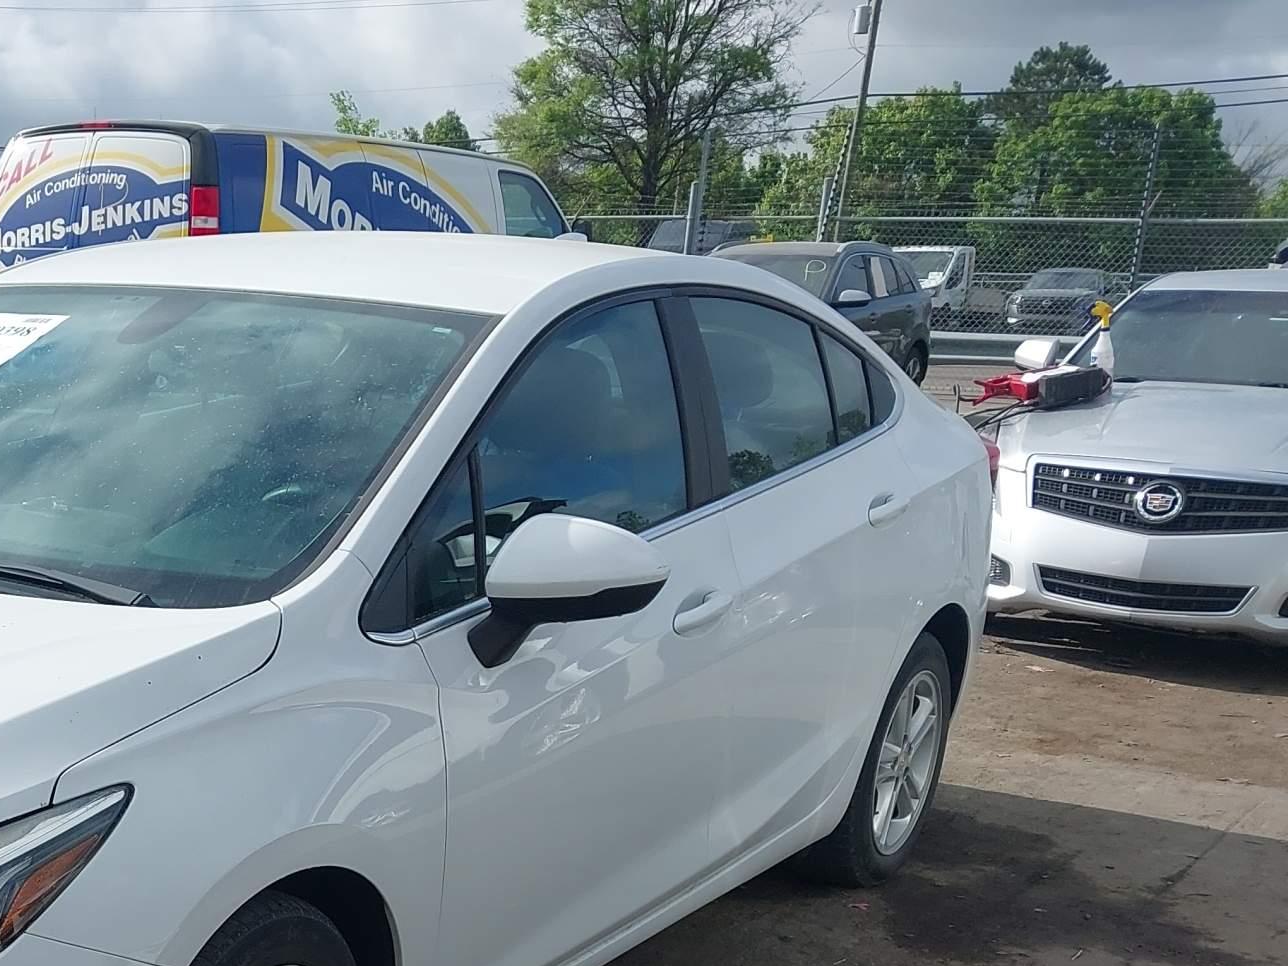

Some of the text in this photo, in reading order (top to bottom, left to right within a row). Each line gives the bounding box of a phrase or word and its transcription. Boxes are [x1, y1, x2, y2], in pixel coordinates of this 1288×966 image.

[25, 169, 127, 209] Air Conditioning
[372, 170, 394, 198] Air
[804, 259, 827, 281] P
